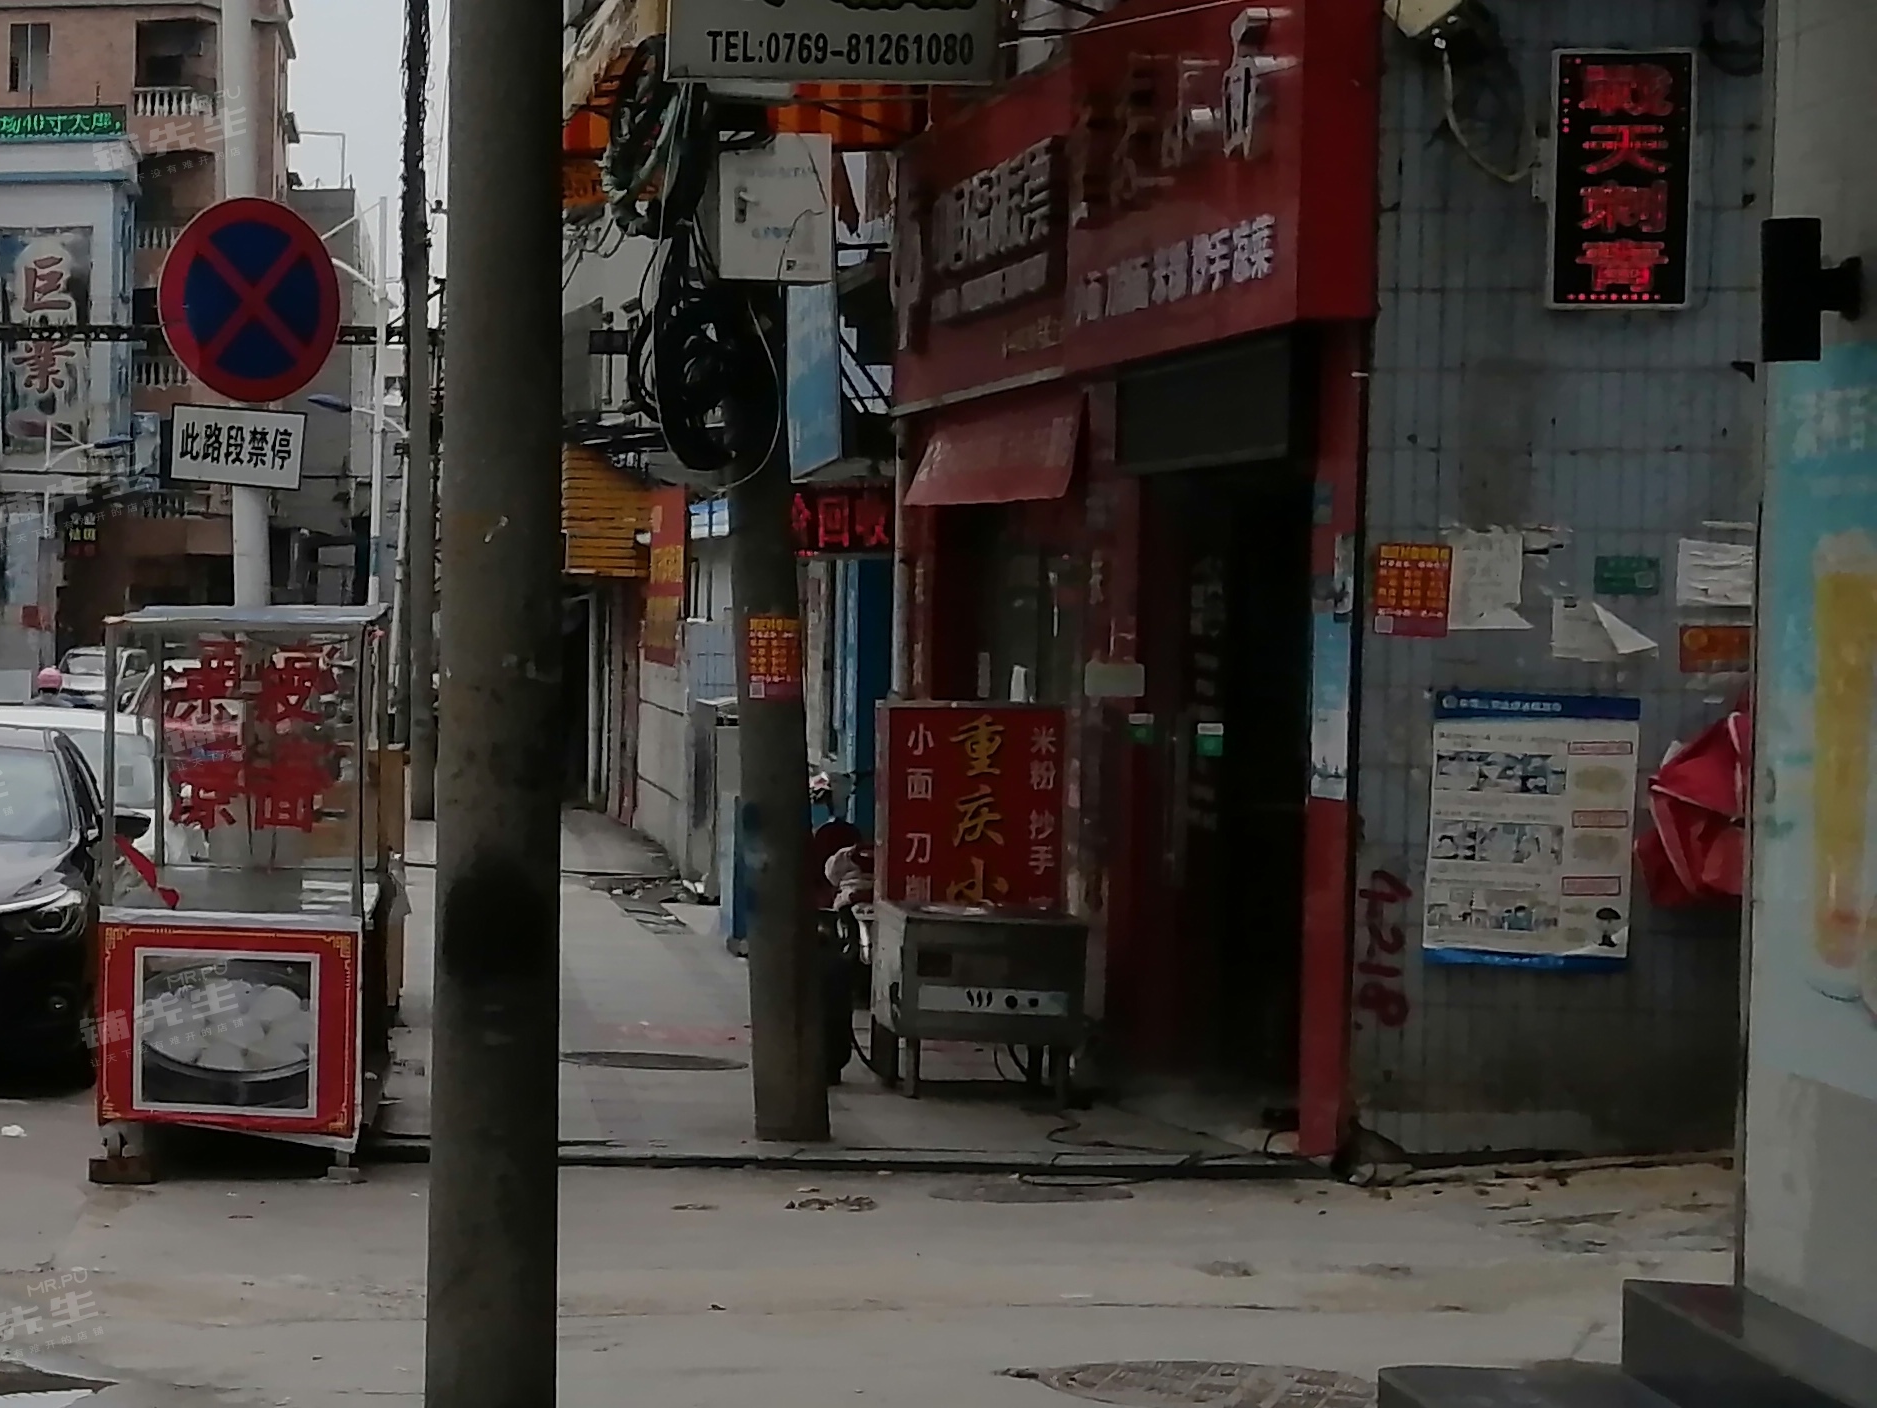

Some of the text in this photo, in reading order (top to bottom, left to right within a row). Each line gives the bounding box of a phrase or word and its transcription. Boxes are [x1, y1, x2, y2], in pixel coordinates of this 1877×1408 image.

[706, 30, 974, 66] TEL:0769-81261080
[179, 421, 294, 471] 此路段禁停
[906, 722, 935, 802] 小面
